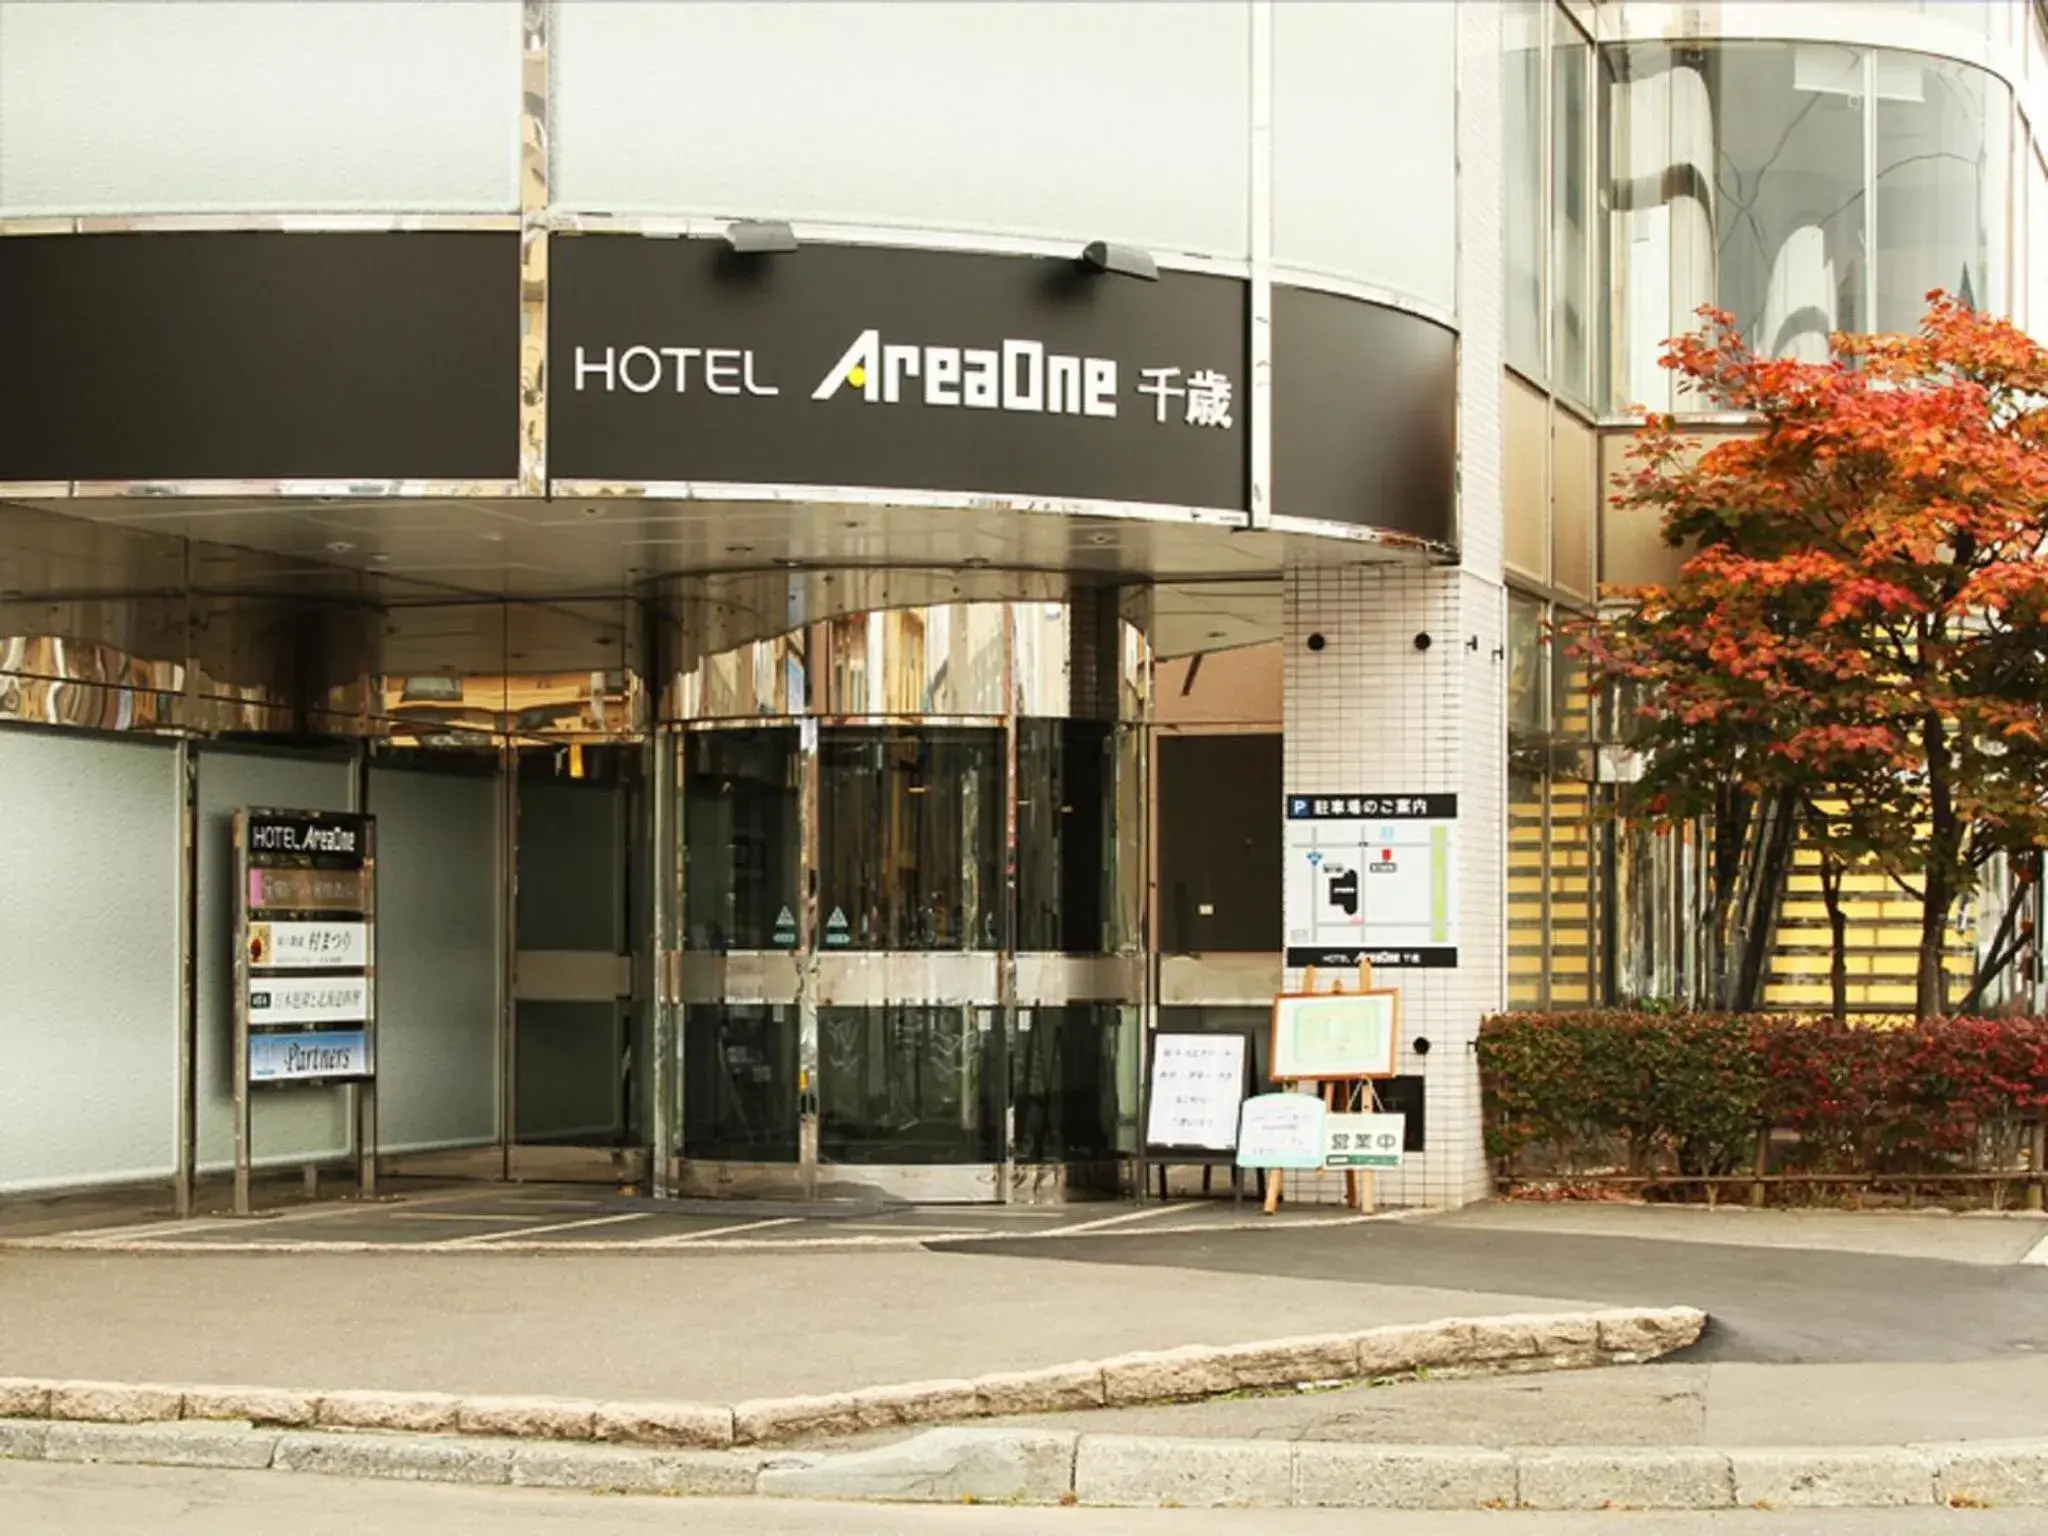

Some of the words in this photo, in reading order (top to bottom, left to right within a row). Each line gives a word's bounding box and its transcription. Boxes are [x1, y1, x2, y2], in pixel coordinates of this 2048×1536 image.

[574, 345, 779, 396] HOTEL
[811, 329, 1118, 418] AreaOne
[1137, 365, 1234, 428] 千歳
[1294, 801, 1307, 814] P
[1313, 799, 1428, 816] 駐車場のご案内
[252, 825, 300, 850] HOTEL
[302, 824, 355, 852] AreaOne
[284, 1038, 352, 1073] Partners
[1331, 1132, 1397, 1151] 営業中
